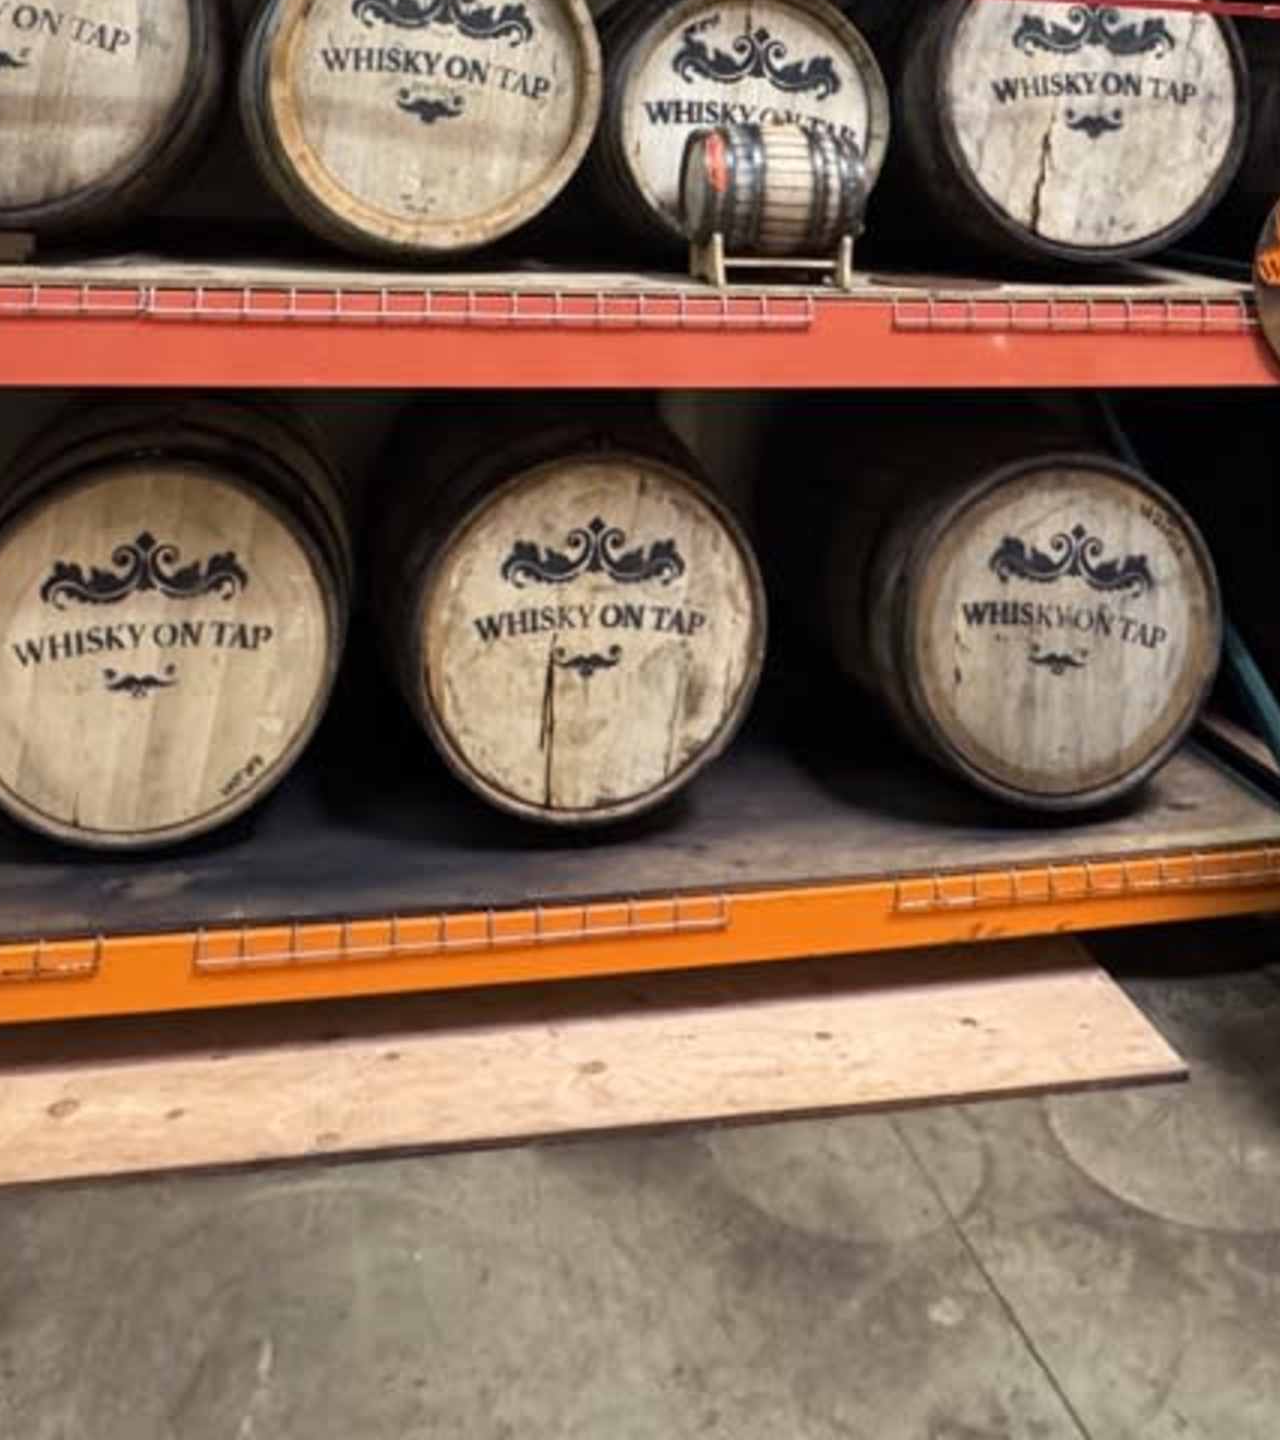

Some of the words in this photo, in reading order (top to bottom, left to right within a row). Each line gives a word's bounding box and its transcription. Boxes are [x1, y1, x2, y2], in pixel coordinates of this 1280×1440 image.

[12, 5, 63, 36] ON
[71, 16, 130, 54] TAP
[321, 46, 443, 77] WHISKY
[445, 54, 491, 85] ON
[492, 65, 549, 101] TAP
[991, 73, 1099, 105] WHISKY
[1100, 72, 1143, 98] ON
[1148, 77, 1197, 105] TAP
[643, 101, 756, 126] WHISKY
[13, 622, 145, 667] WHISKY
[152, 620, 202, 649] ON
[210, 620, 274, 651] TAP
[474, 606, 597, 643] WHISKY
[598, 604, 643, 630] ON
[651, 606, 706, 636] TAP
[962, 601, 1072, 628] WHISKY
[1073, 608, 1110, 637] ON
[1115, 617, 1168, 649] TAP
